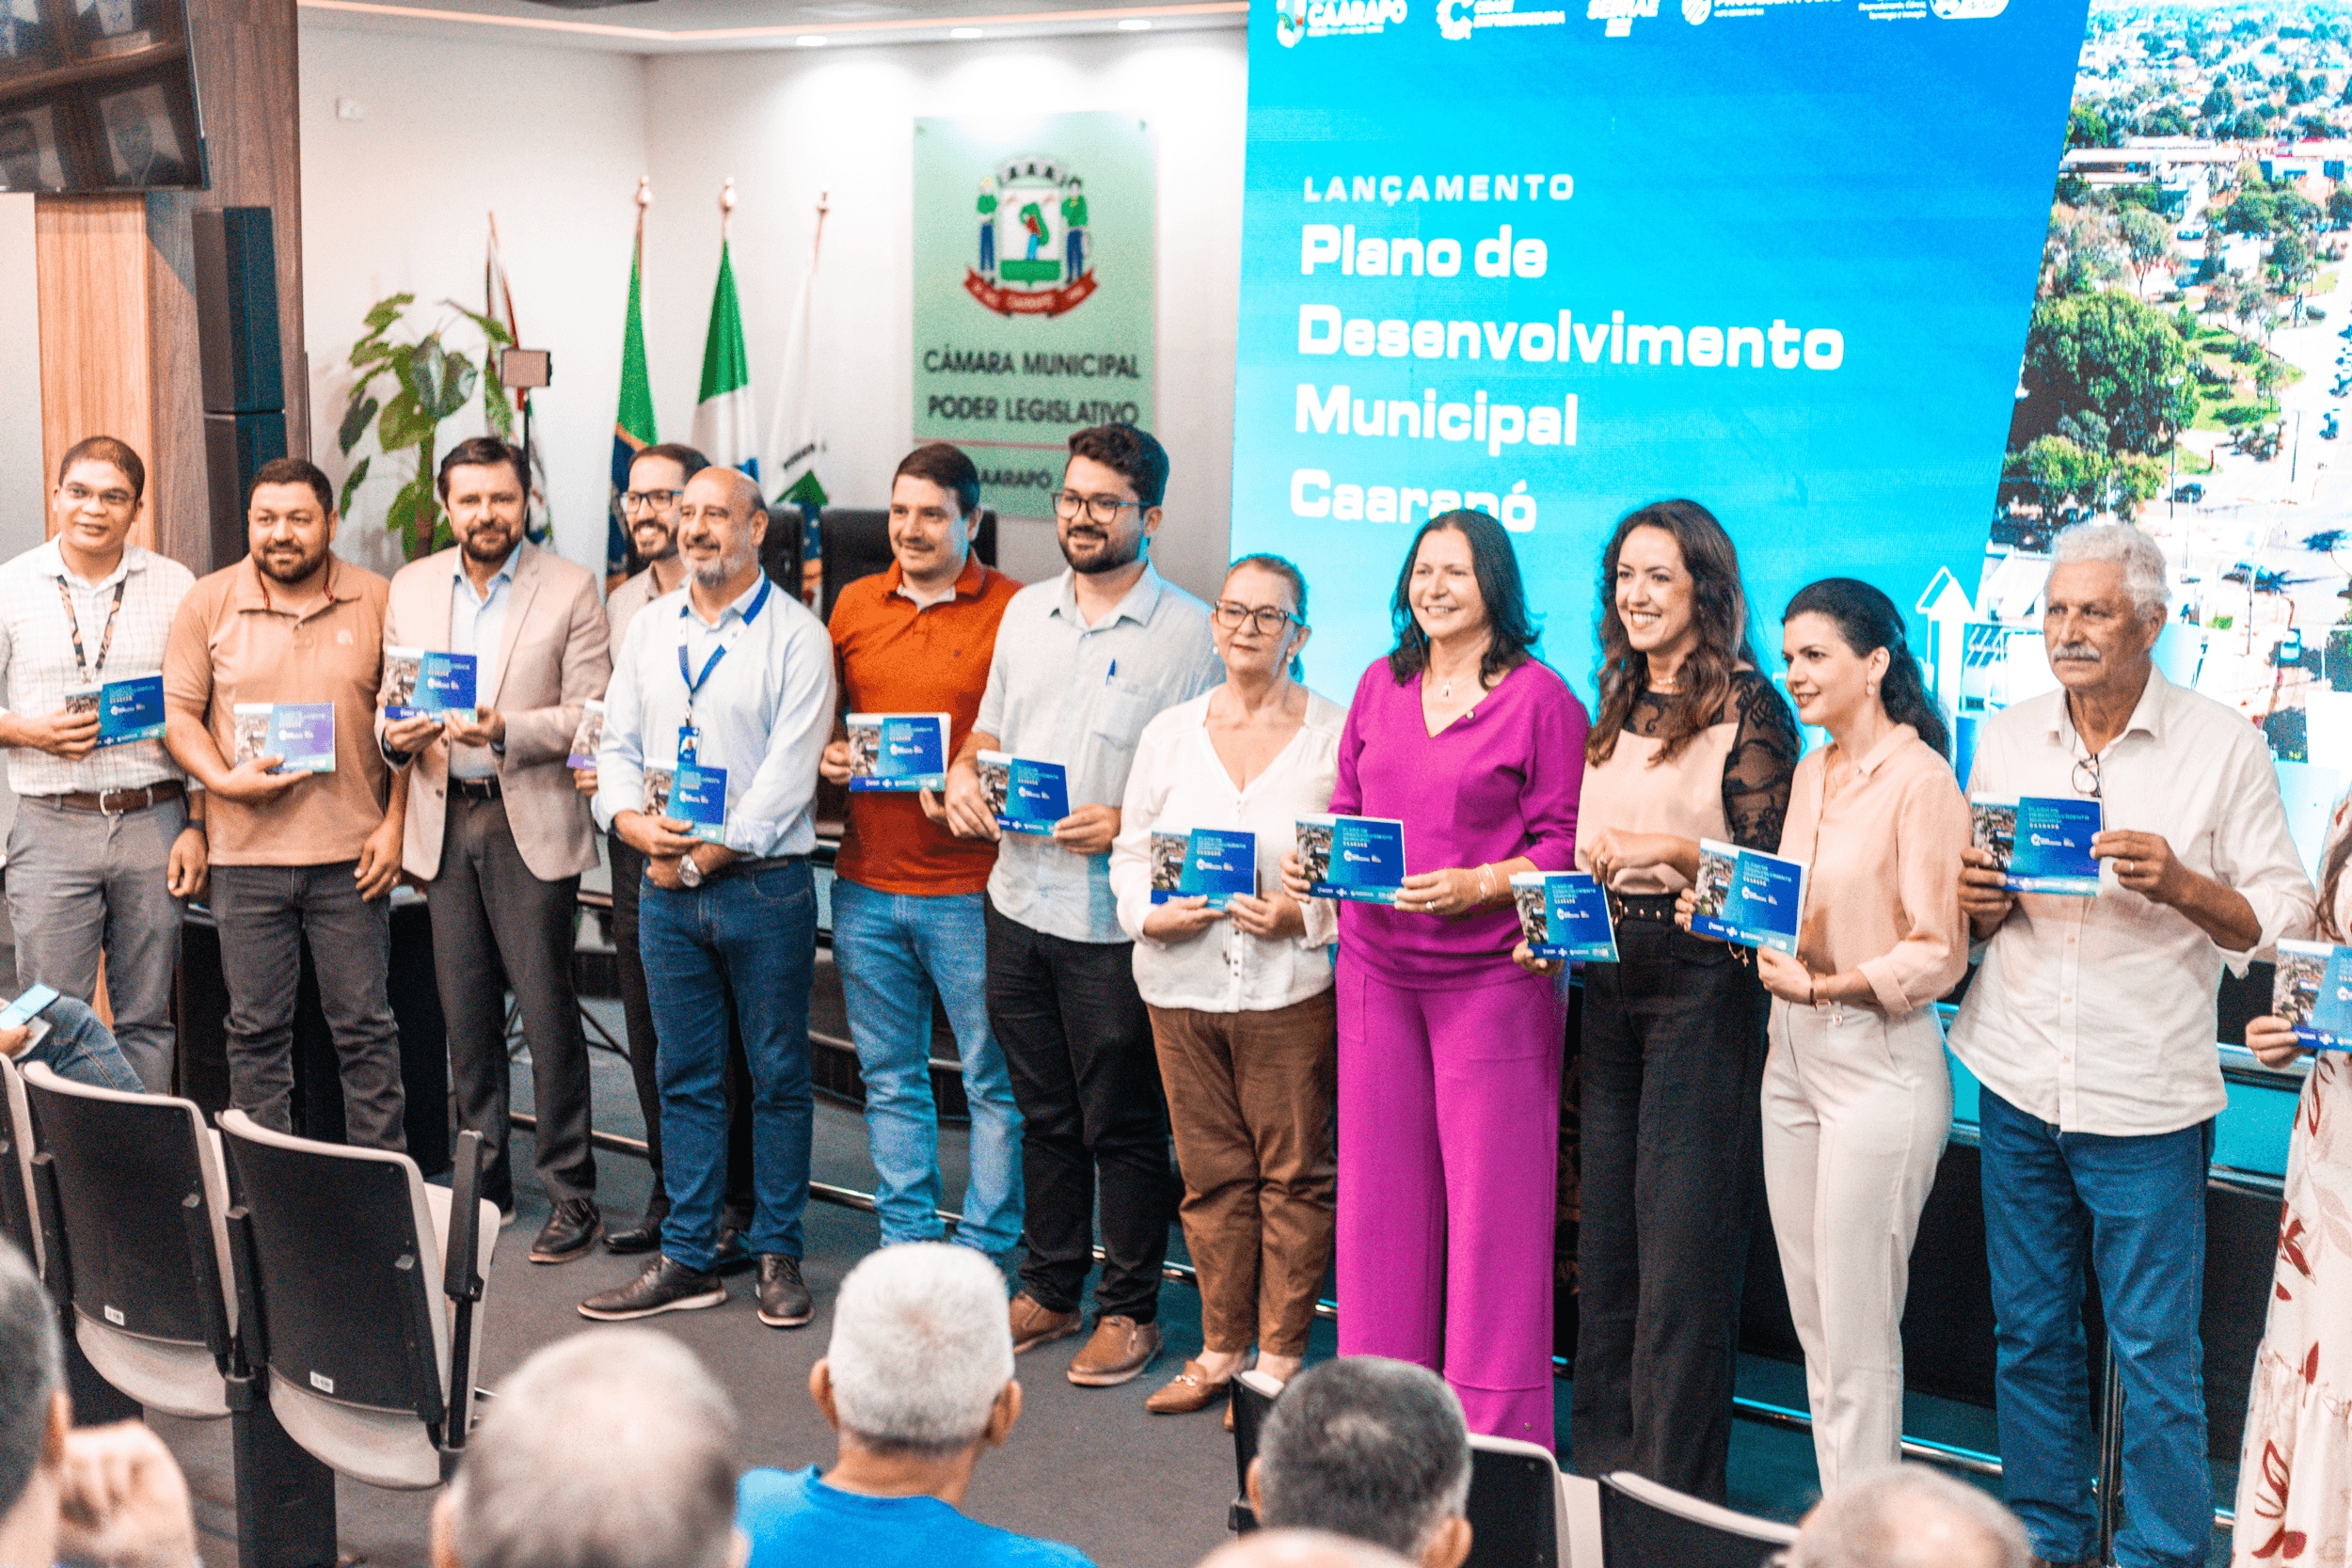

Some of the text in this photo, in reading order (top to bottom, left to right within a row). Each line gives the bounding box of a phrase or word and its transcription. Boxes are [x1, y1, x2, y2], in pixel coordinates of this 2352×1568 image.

[1304, 175, 1574, 205] LANÇAMENTO
[1300, 224, 1548, 278] Plano de
[1297, 304, 1844, 370] Desenvolvimento
[1022, 351, 1141, 379] MUNICIPAL
[927, 395, 1139, 425] PODER LEGISLATIVO
[1295, 383, 1579, 457] Municipal
